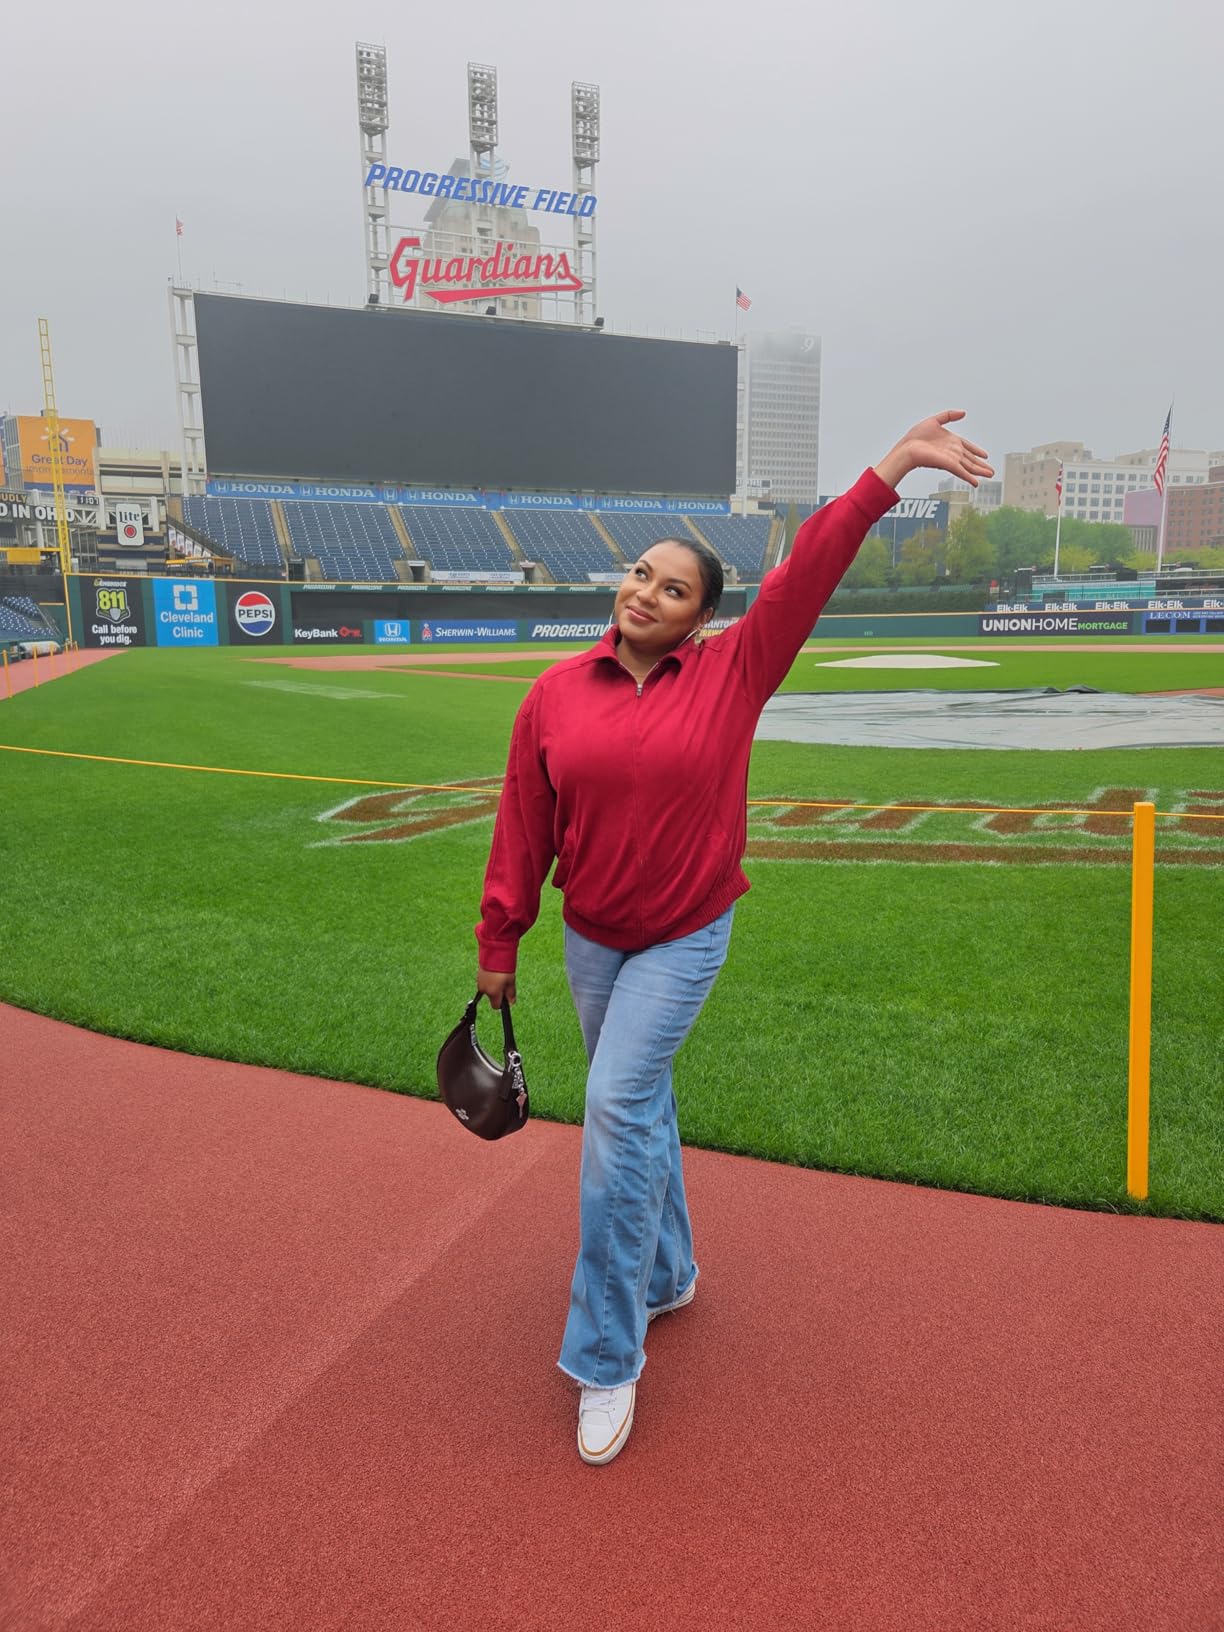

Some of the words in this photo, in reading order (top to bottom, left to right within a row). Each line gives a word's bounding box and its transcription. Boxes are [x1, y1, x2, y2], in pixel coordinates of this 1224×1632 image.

[365, 163, 530, 208] PROGRESSIVE
[533, 189, 598, 217] FIELD
[388, 236, 584, 303] Guardians
[32, 454, 63, 465] Great
[66, 455, 88, 467] Day
[231, 483, 296, 495] HONDA
[315, 487, 376, 498] HONDA
[421, 491, 477, 502] HONDA
[0, 493, 27, 503] UDLY
[521, 495, 574, 506] HONDA
[12, 504, 31, 519] IN
[614, 499, 663, 509] HONDA
[677, 501, 724, 512] HONDA
[118, 511, 140, 523] Lite
[98, 590, 126, 610] 811
[160, 611, 214, 623] Cleveland
[238, 609, 273, 619] PEPSI
[1149, 611, 1191, 619] LECOM
[92, 624, 109, 634] Call
[110, 624, 138, 634] before
[172, 626, 204, 638] Clinic
[532, 624, 611, 638] PROGRESSIV
[1078, 622, 1128, 630] MORTGAGE
[99, 634, 116, 645] you
[116, 634, 132, 645] dig.
[294, 628, 338, 639] KeyBank
